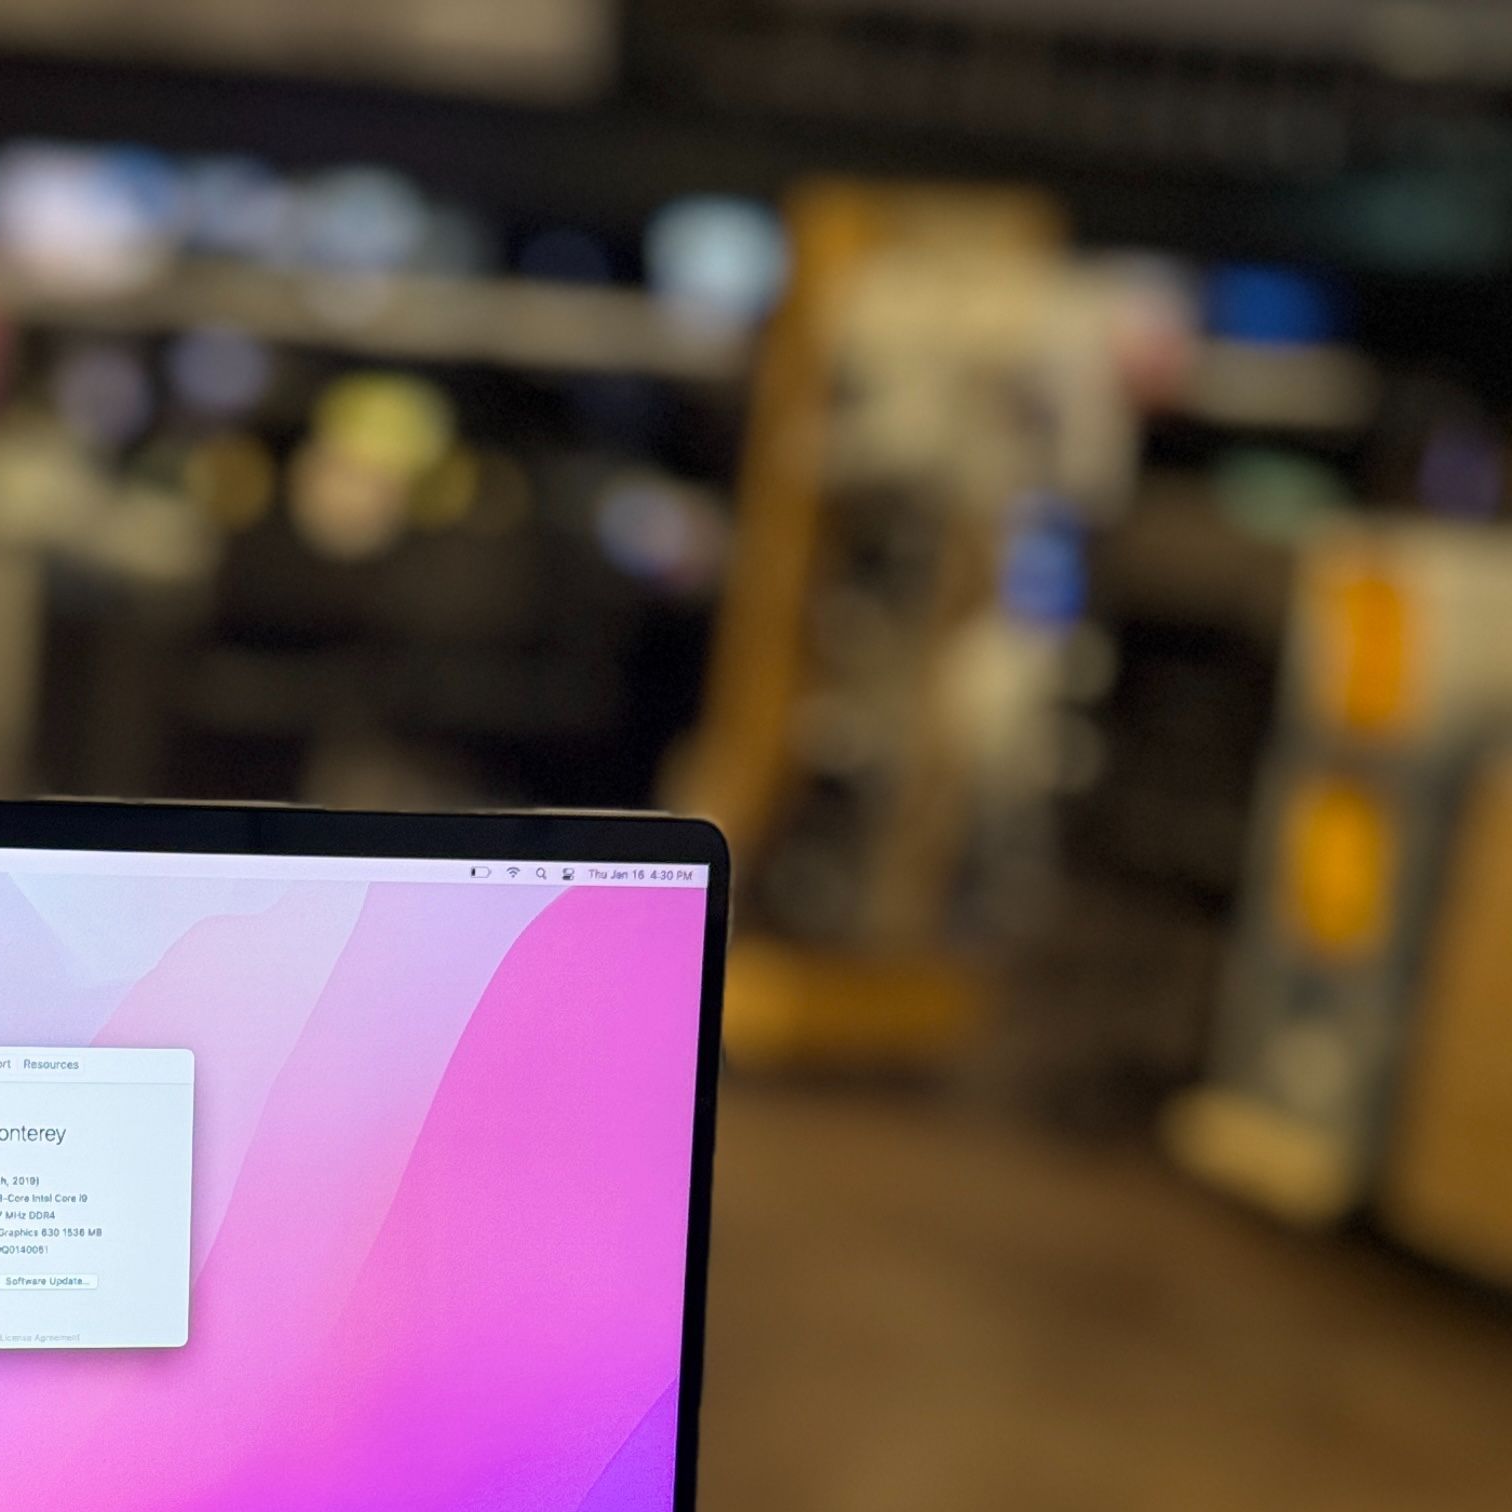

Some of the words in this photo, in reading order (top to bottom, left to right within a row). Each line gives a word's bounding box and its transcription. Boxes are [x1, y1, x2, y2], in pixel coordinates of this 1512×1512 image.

[588, 869, 607, 880] Thu
[610, 869, 628, 880] Jan
[649, 869, 674, 881] 4:30
[676, 870, 693, 881] PM
[23, 1059, 80, 1070] Resources
[32, 1194, 53, 1203] Intel
[55, 1194, 76, 1203] Core
[78, 1194, 88, 1203] i9
[5, 1211, 27, 1220] MHz
[29, 1211, 55, 1220] DDR4
[88, 1228, 102, 1238] MB
[5, 1276, 47, 1286] Software
